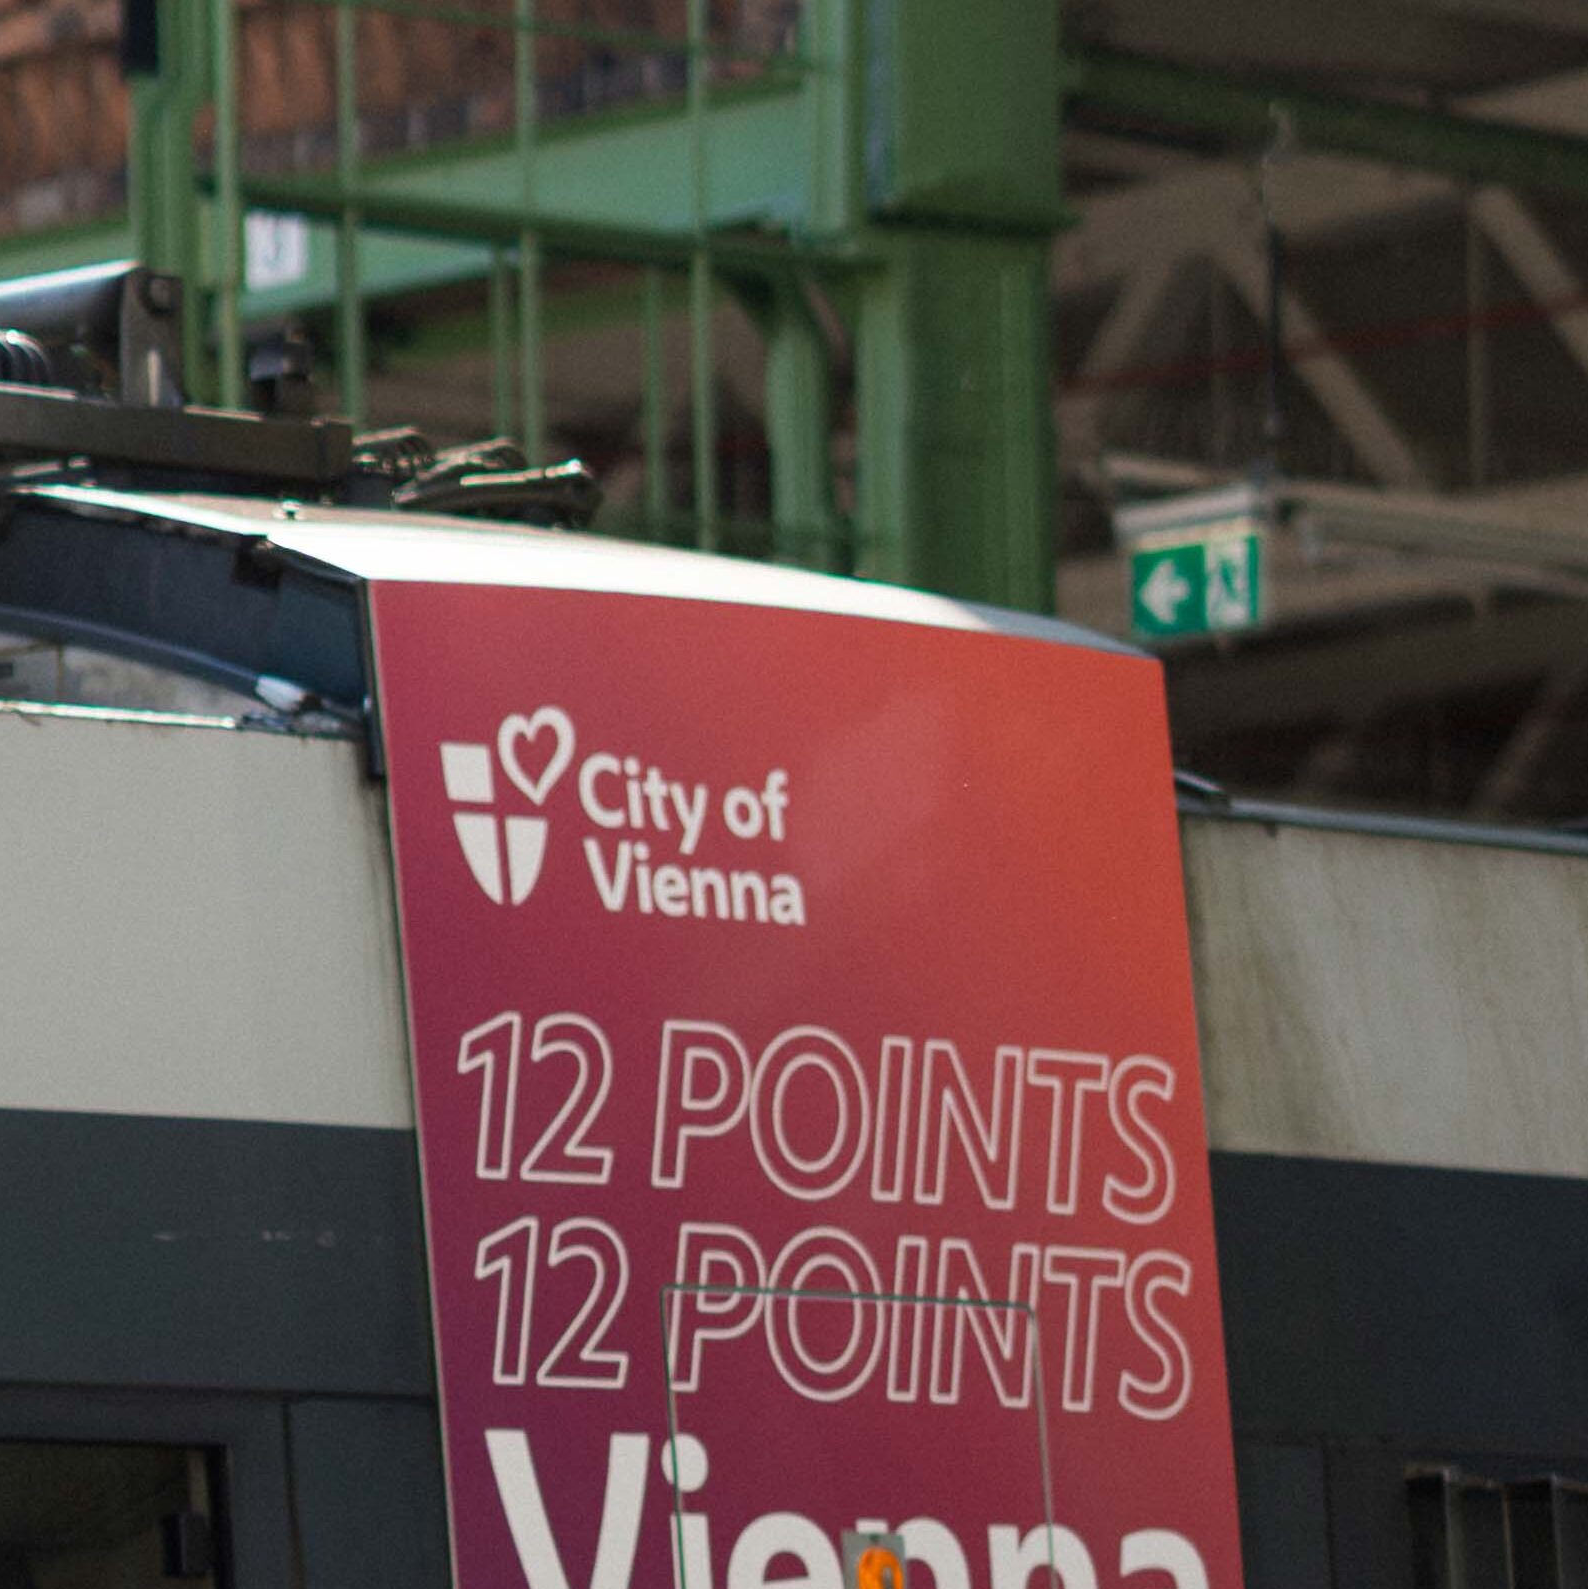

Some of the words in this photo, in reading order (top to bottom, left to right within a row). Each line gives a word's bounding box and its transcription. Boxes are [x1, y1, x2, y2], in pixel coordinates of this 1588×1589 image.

[578, 751, 708, 855] City
[722, 768, 789, 843] of
[582, 837, 806, 927] Vienna
[456, 1011, 614, 1184] 12
[650, 1019, 1178, 1225] POINTS
[474, 1215, 630, 1390] 12
[669, 1222, 1193, 1421] POINTS
